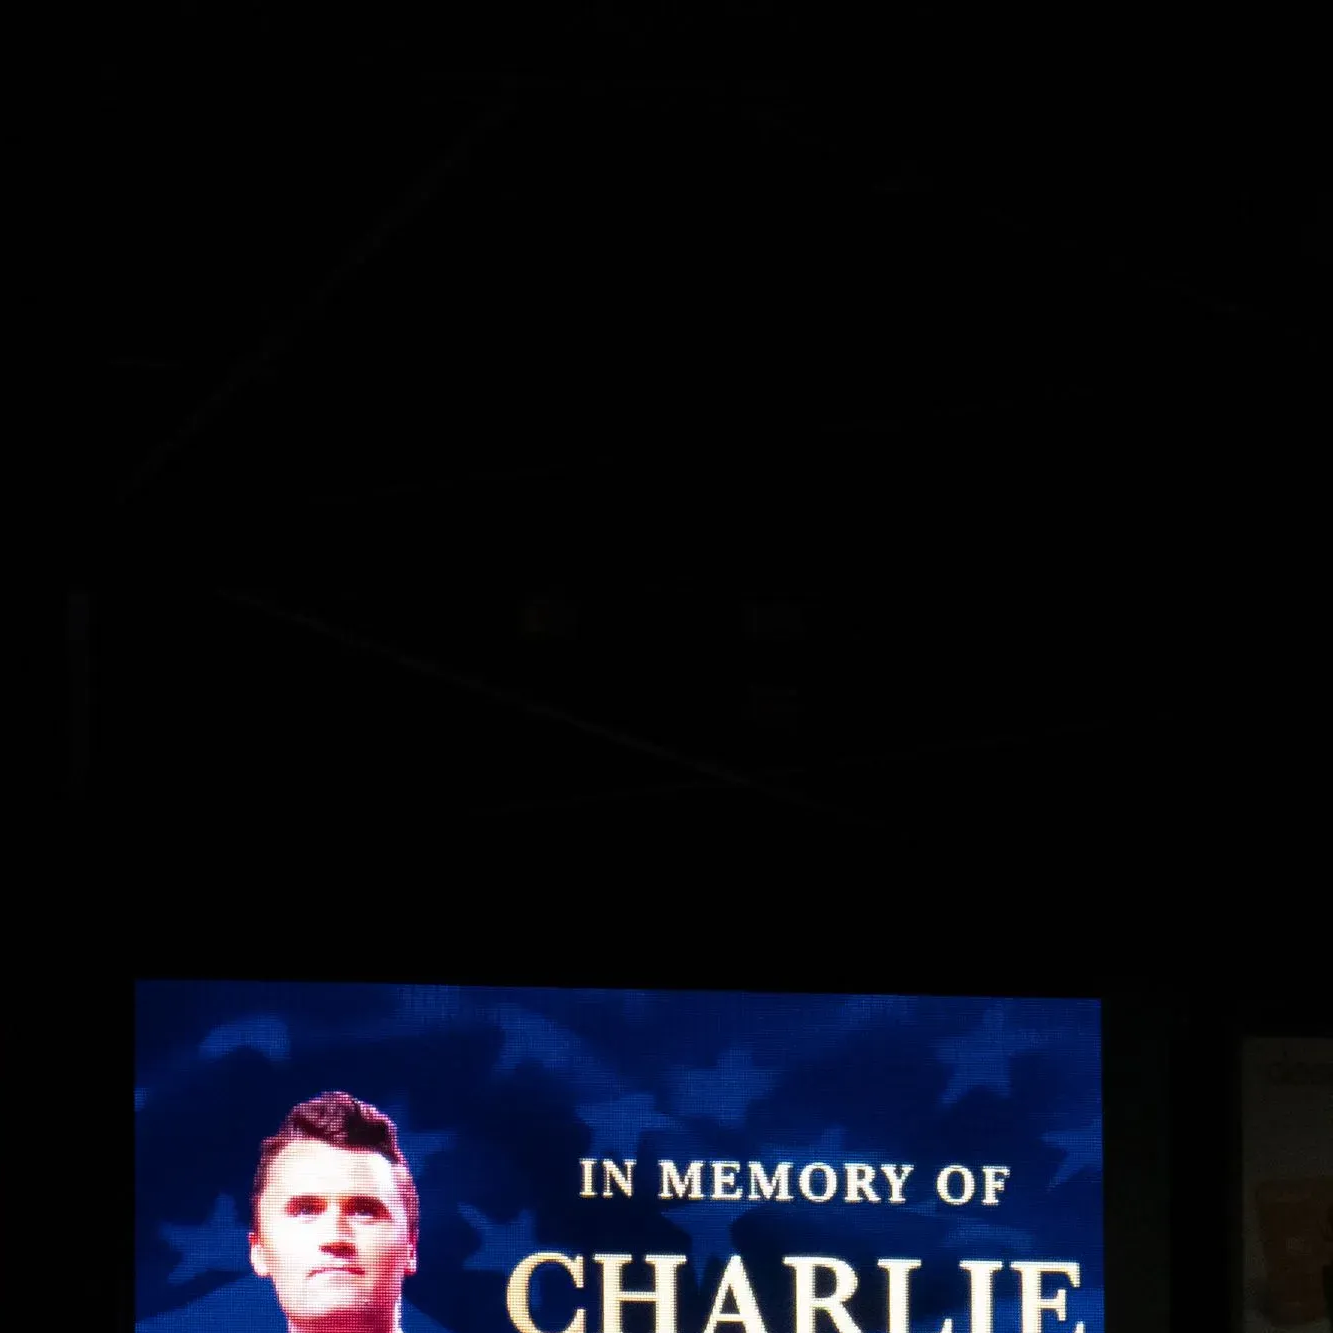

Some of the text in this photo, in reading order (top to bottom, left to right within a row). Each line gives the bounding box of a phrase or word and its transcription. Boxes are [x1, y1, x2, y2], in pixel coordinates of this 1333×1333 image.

[579, 1157, 1011, 1206] IN MEMORY OF
